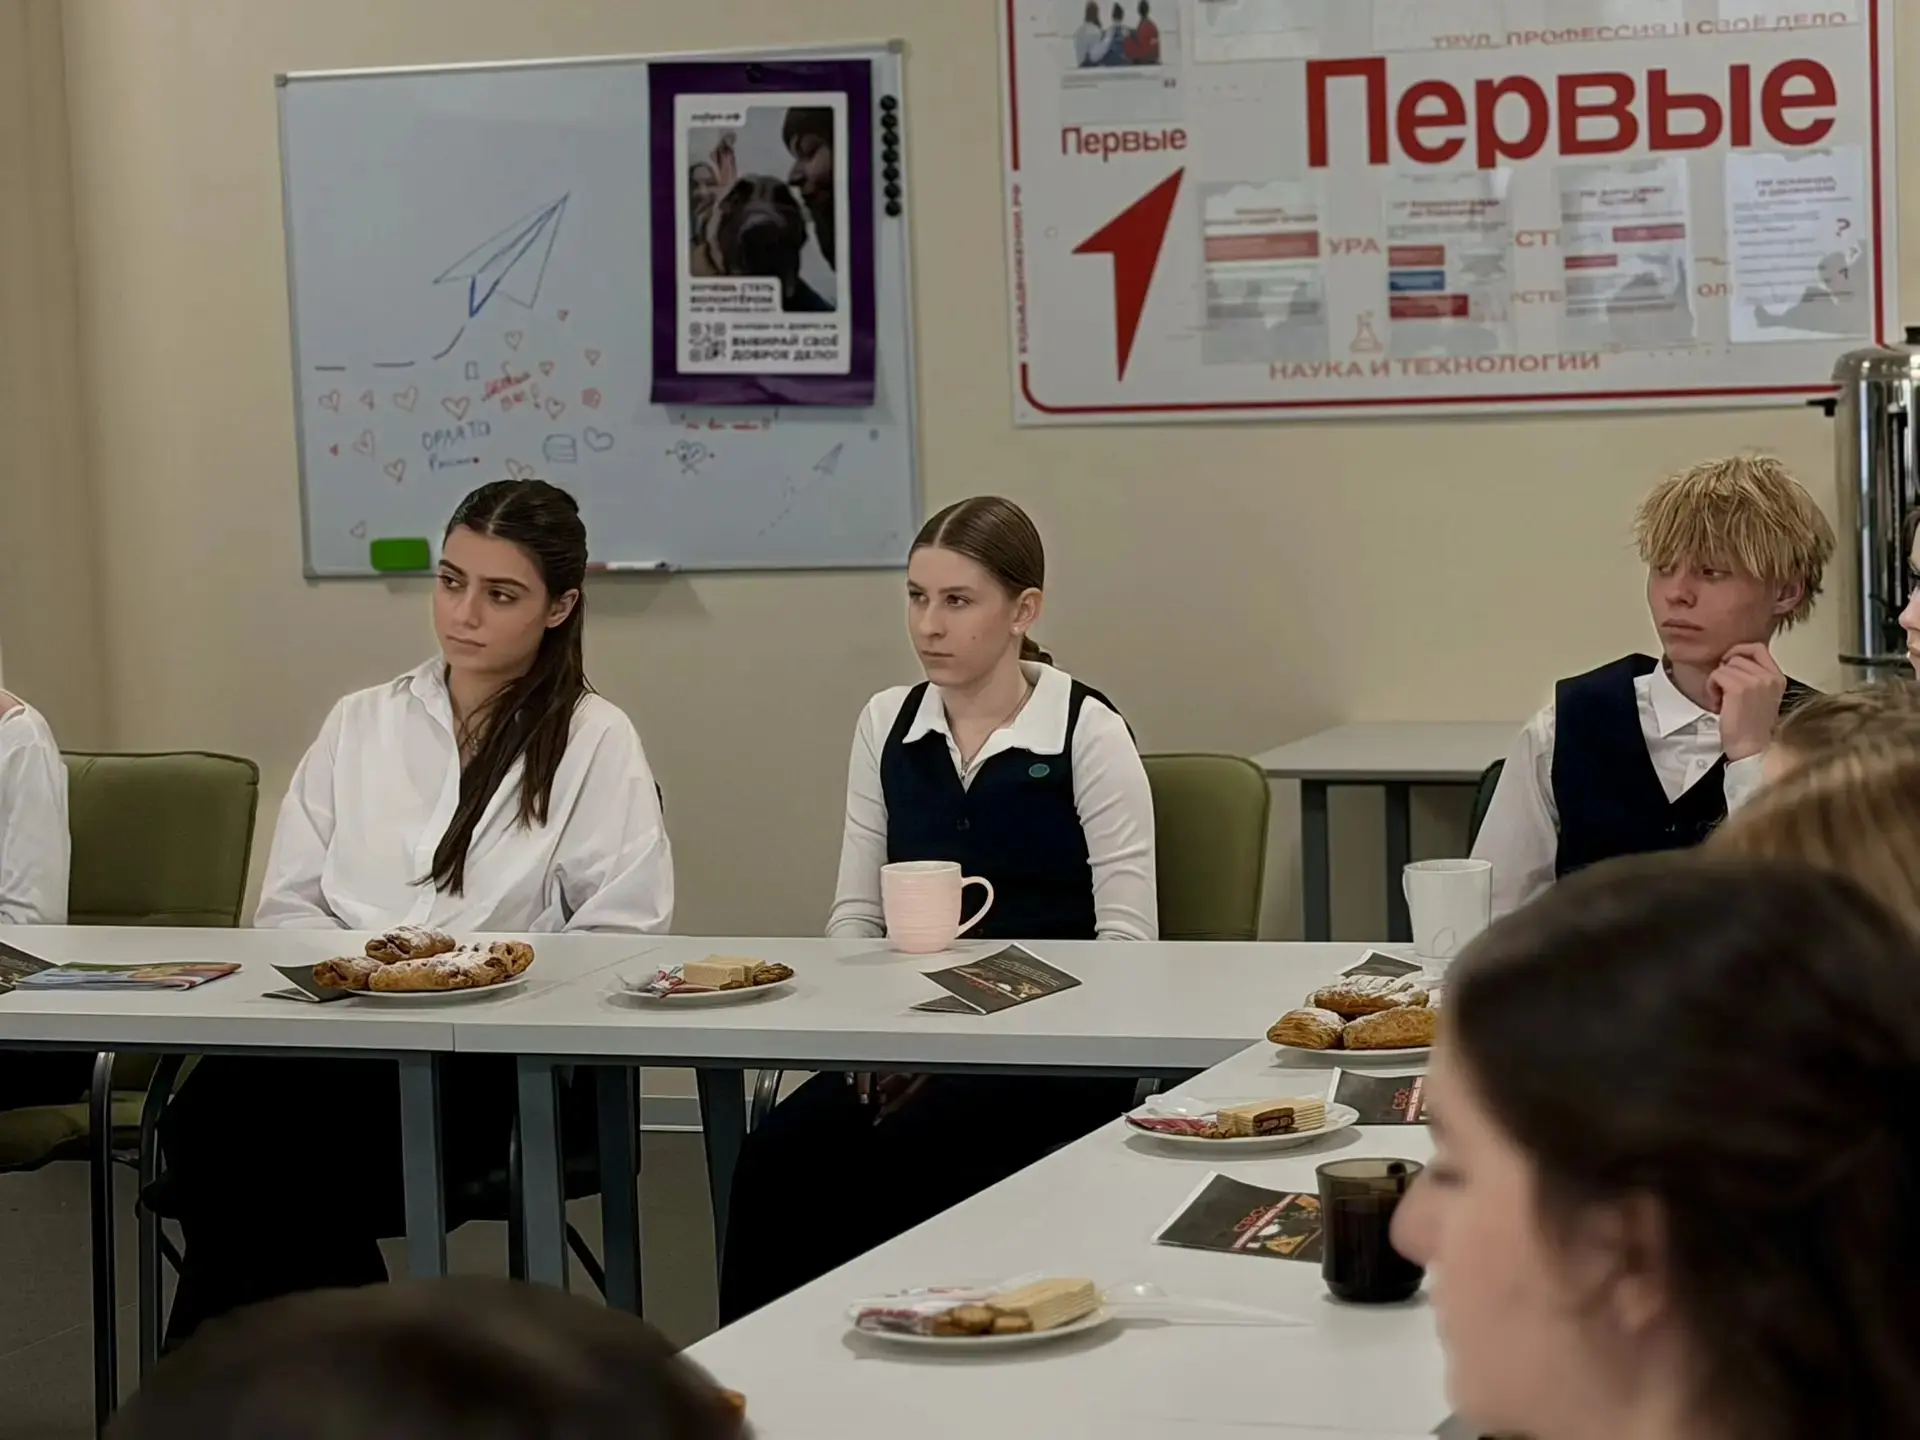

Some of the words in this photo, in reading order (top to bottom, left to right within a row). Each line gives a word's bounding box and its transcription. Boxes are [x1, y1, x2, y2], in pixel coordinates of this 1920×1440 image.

[1306, 57, 1837, 170] Первые
[1061, 127, 1187, 162] Первые
[1327, 237, 1381, 255] УРА
[731, 333, 799, 346] ВЫБИРАЙ
[802, 333, 839, 346] СВОЁ
[731, 349, 790, 361] ДОБРОЕ
[1269, 360, 1364, 380] НАУКА
[1371, 358, 1390, 377] И
[1397, 352, 1600, 377] ТЕХНОЛОГИИ
